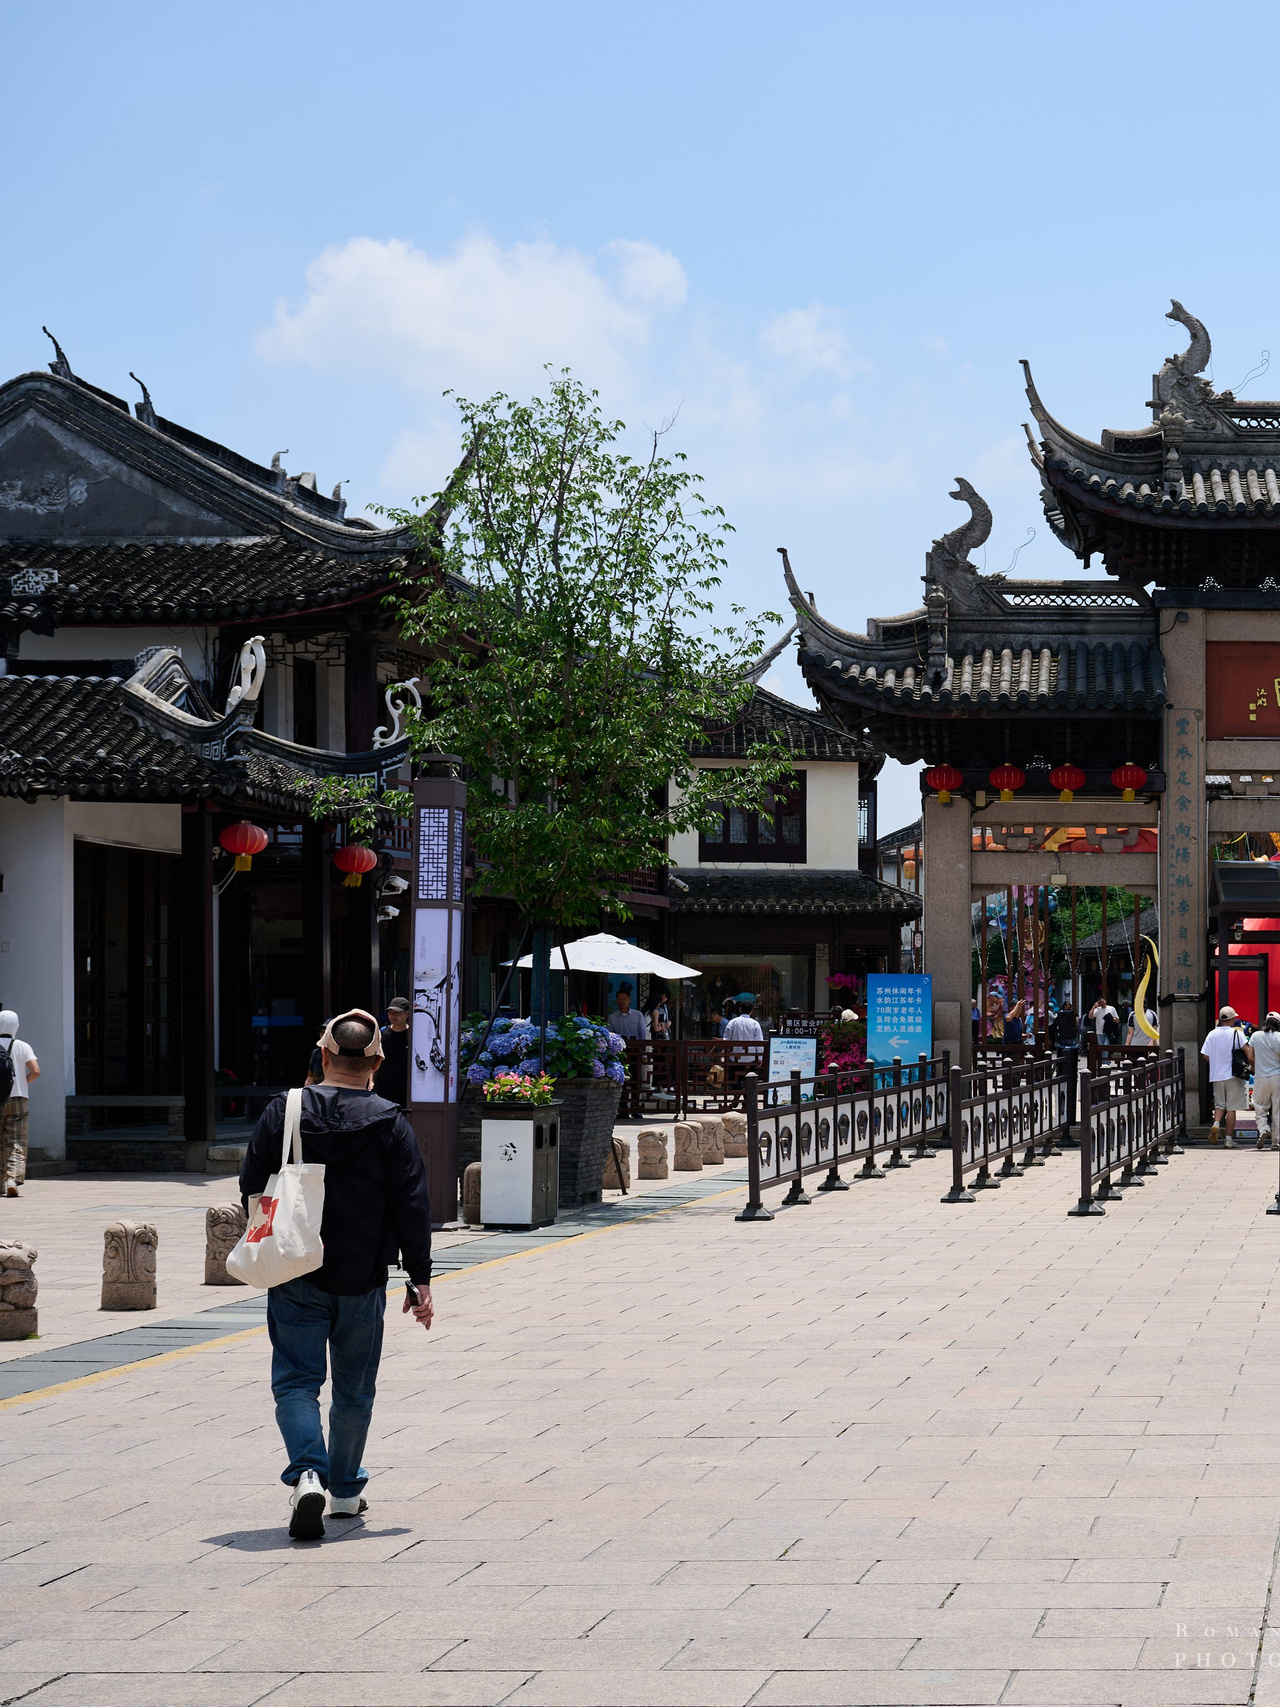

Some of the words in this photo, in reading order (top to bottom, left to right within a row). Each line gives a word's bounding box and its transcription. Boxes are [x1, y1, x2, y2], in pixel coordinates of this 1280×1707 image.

[876, 987, 922, 995] 苏州休闲年卡
[876, 1025, 922, 1033] 定的人员通道
